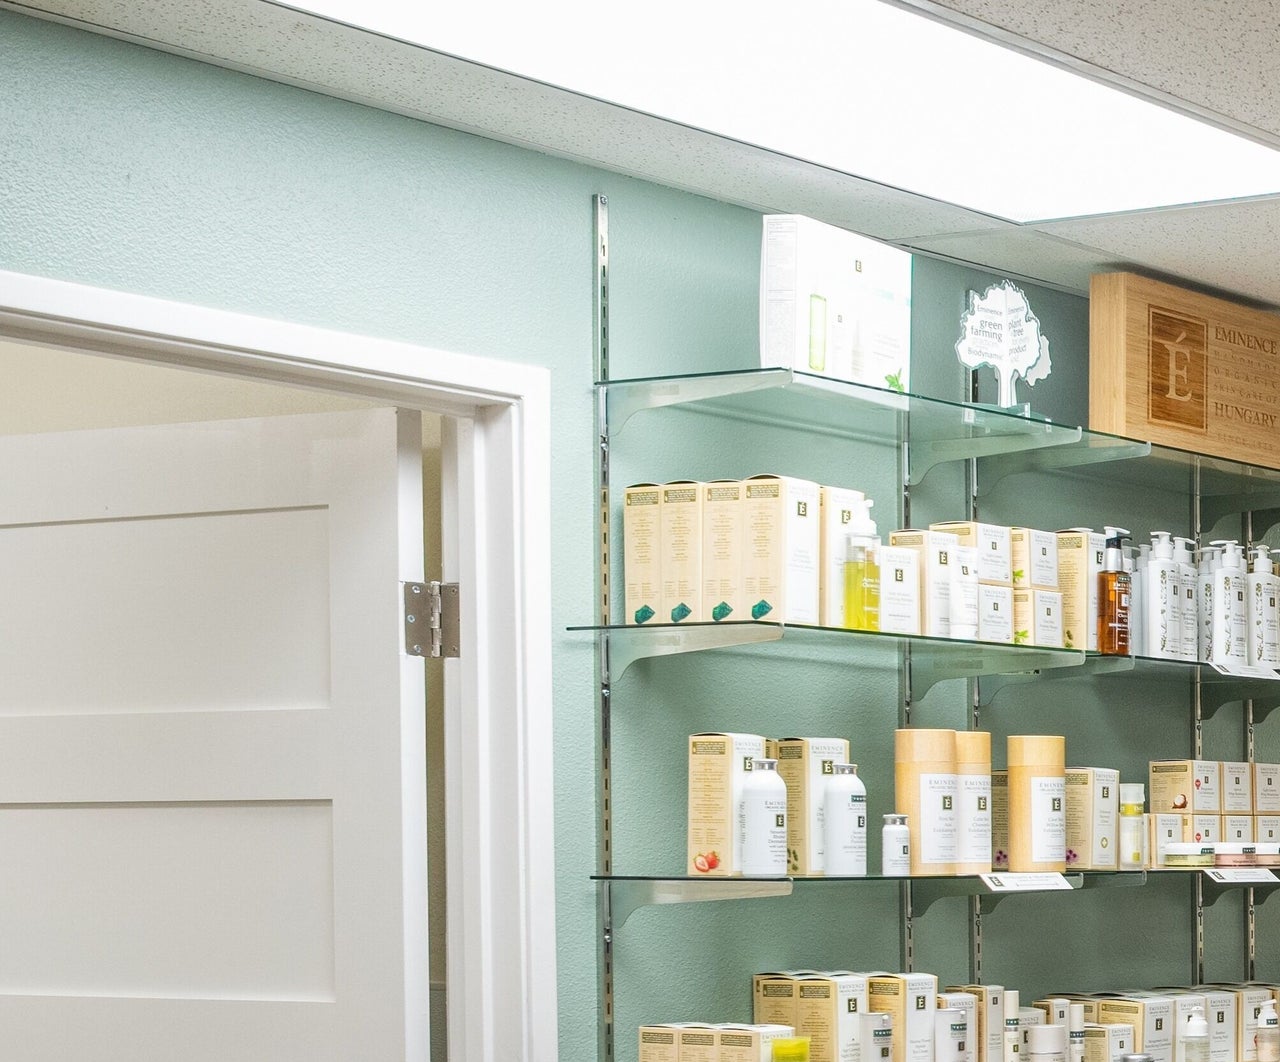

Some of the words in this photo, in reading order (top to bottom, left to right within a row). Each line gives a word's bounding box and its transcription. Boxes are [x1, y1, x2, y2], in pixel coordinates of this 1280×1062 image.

[971, 325, 1003, 342] farming
[980, 320, 1003, 331] green
[1214, 367, 1277, 388] ORGANIC
[1214, 402, 1277, 428] HUNGARY
